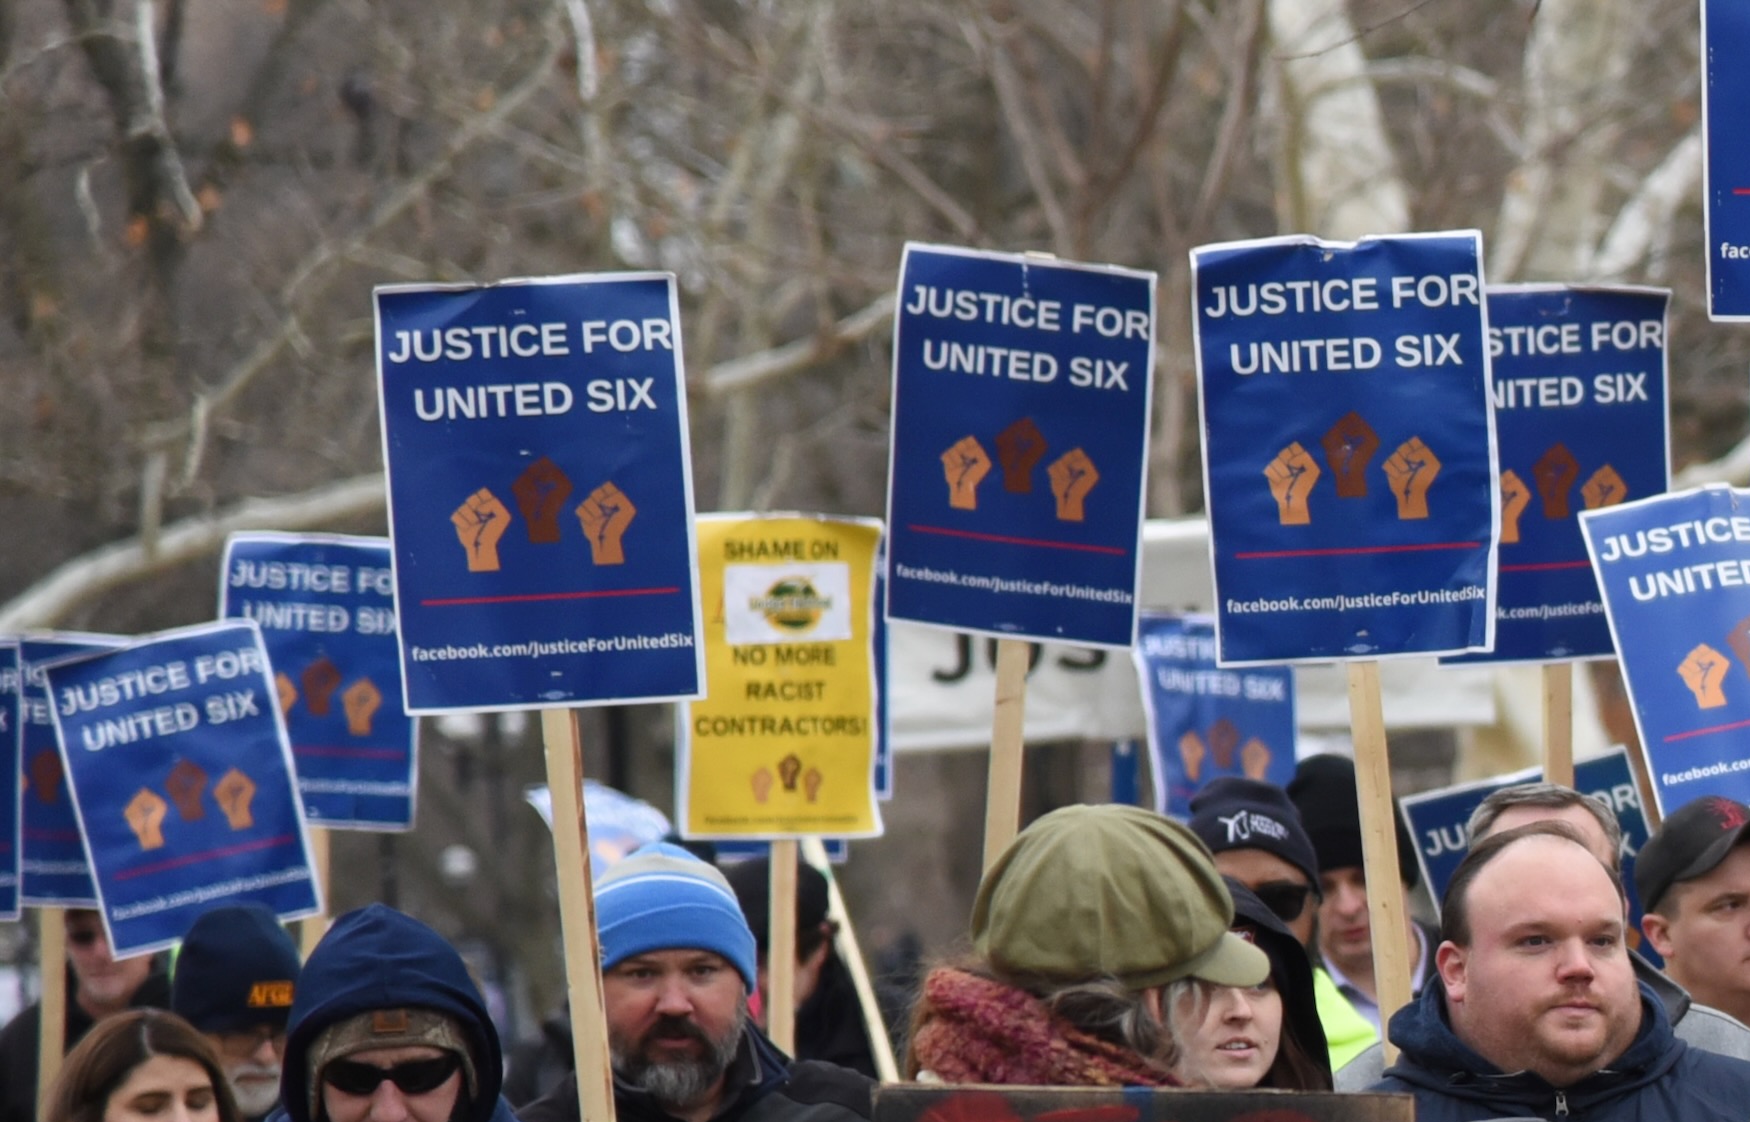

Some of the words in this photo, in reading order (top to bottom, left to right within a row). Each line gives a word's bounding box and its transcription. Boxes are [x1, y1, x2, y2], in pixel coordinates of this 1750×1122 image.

[906, 284, 1061, 331] JUSTICE
[1072, 303, 1149, 341] FOR
[1205, 278, 1379, 318] JUSTICE
[1392, 274, 1479, 308] FOR
[388, 322, 569, 363] JUSTICE
[581, 318, 673, 354] FOR
[1230, 338, 1382, 375] UNITED
[1395, 333, 1462, 368] SIX
[1488, 324, 1581, 357] STICE
[1590, 320, 1663, 352] FOR
[922, 339, 1058, 383] UNITED
[1069, 357, 1129, 391] SIX
[414, 382, 573, 421] UNITED
[586, 377, 657, 412] SIX
[1492, 376, 1584, 409] NITED
[1594, 372, 1648, 404] SIX
[724, 538, 806, 560] SHAME
[812, 539, 839, 560] ON
[230, 559, 351, 593] JUSTICE
[357, 566, 395, 596] FO
[896, 563, 1132, 604] facebook.com/JusticeForUnitedSix
[243, 600, 350, 632] UNITED
[1227, 585, 1485, 614] facebook.com/JusticeForUnitedSix
[412, 633, 693, 661] facebook.com/JusticeForUnitedSix
[732, 646, 768, 667] NO
[775, 645, 837, 667] MORE
[61, 661, 191, 717] JUSTICE
[195, 647, 264, 684] FOR
[745, 681, 826, 702] RACIST
[1157, 666, 1241, 697] UNITED
[1243, 674, 1286, 701] SIX
[81, 701, 199, 751] UNITED
[205, 689, 259, 725] SIX
[694, 716, 868, 738] CONTRACTORS!
[1592, 783, 1639, 813] OR
